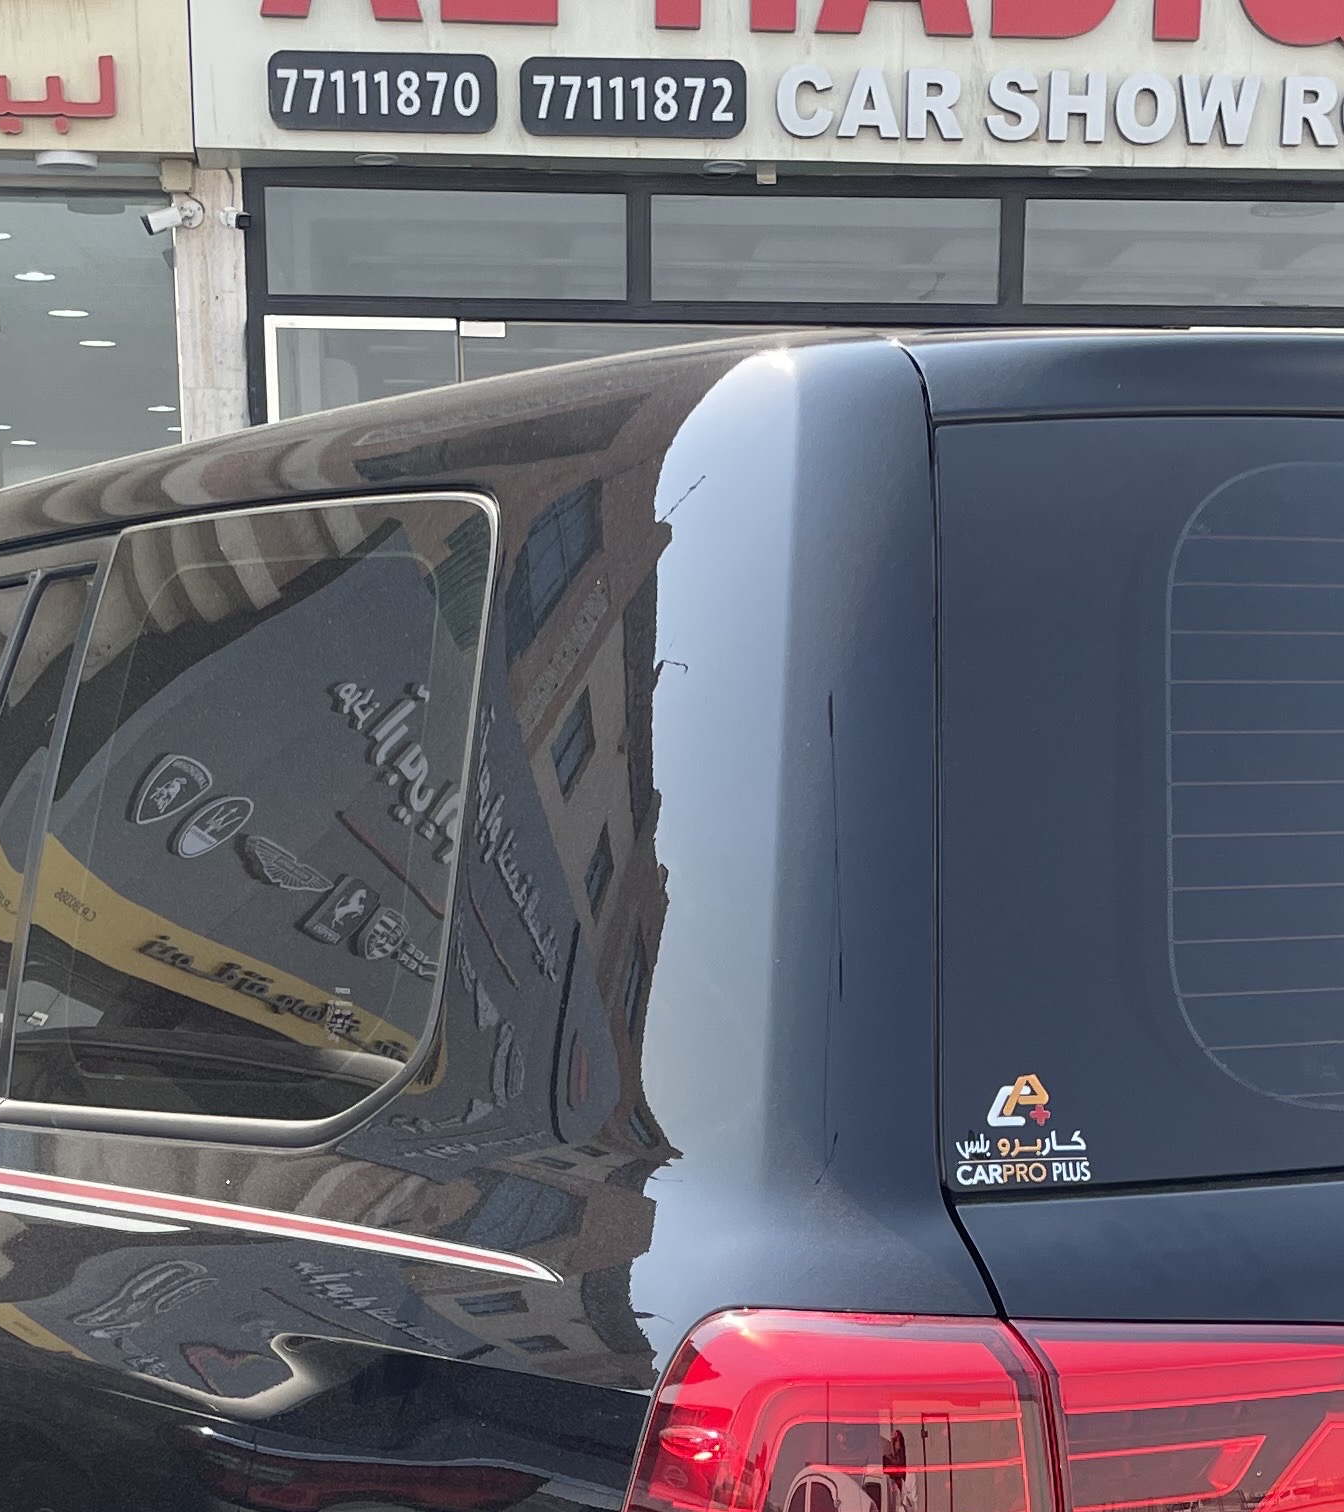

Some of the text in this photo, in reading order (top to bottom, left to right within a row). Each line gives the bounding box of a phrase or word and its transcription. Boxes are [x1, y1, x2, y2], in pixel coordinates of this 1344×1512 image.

[276, 67, 481, 118] 77111870
[532, 75, 734, 122] 77111872
[776, 64, 964, 141] CAR
[986, 68, 1261, 147] SHOW
[956, 1161, 1091, 1185] CARPRO PLUS
